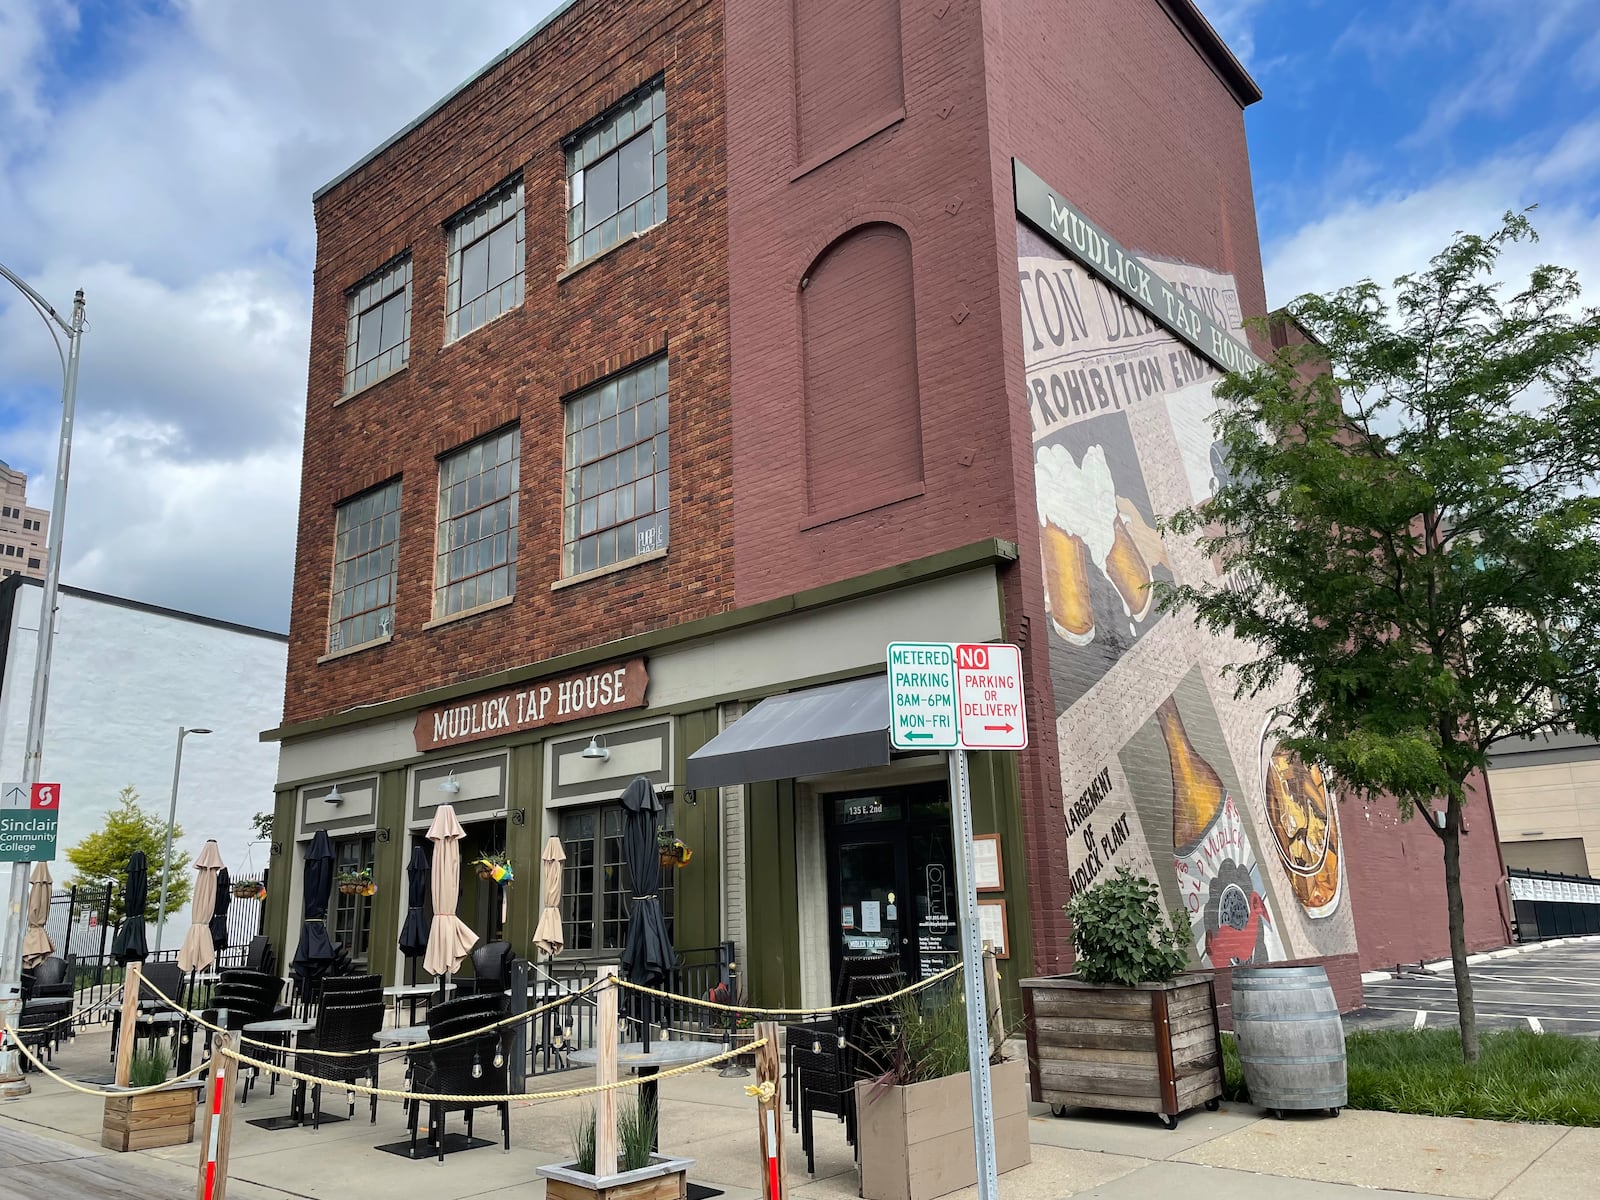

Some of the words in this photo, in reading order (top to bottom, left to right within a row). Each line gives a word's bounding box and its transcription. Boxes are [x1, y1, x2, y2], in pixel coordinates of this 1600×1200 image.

[1048, 193, 1154, 307] MUDLICK
[1162, 283, 1202, 341] TAP
[1019, 268, 1088, 351] TON
[893, 651, 949, 665] METERED
[959, 648, 987, 668] NO
[896, 673, 949, 687] PARKING
[965, 675, 1014, 688] PARKING
[896, 694, 951, 707] 8AM-6PM
[984, 690, 997, 701] OR
[432, 696, 511, 742] MUDLICK
[516, 686, 552, 724] TAP
[557, 669, 626, 716] HOUSE
[964, 704, 1018, 717] DELIVERY
[900, 714, 950, 728] MON-FRI
[849, 806, 861, 816] 135
[869, 804, 883, 814] 2nd
[1, 818, 57, 831] Sinclair
[0, 833, 56, 842] Community
[1083, 823, 1096, 852] OF
[1101, 812, 1130, 860] PLANT
[0, 843, 36, 853] College
[1203, 828, 1243, 866] MUDLICK
